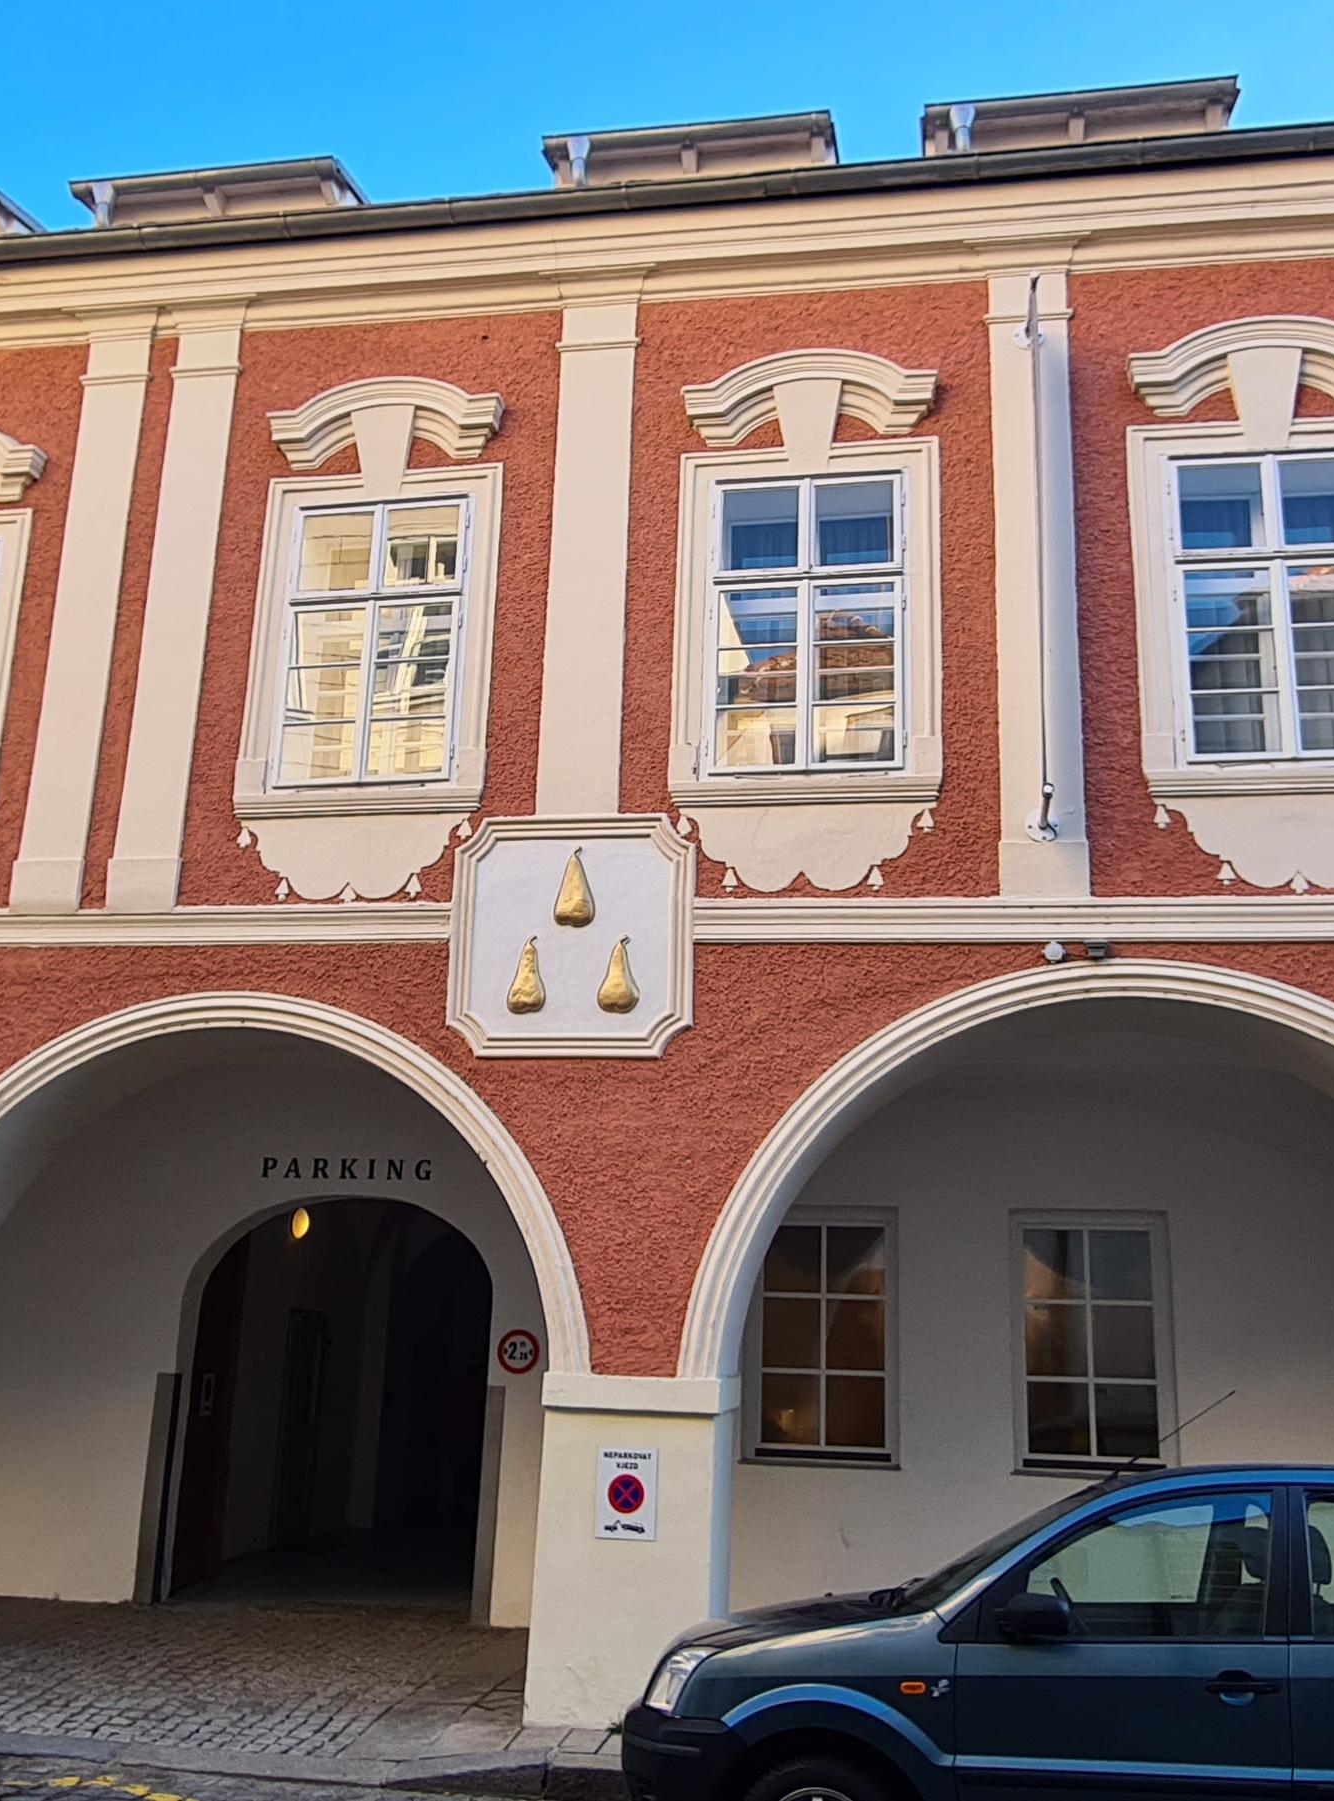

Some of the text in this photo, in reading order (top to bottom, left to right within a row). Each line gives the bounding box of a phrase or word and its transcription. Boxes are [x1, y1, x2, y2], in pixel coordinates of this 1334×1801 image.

[261, 1157, 433, 1181] PARKING
[508, 1341, 517, 1360] 2
[603, 1452, 652, 1460] NEPARKOVAT
